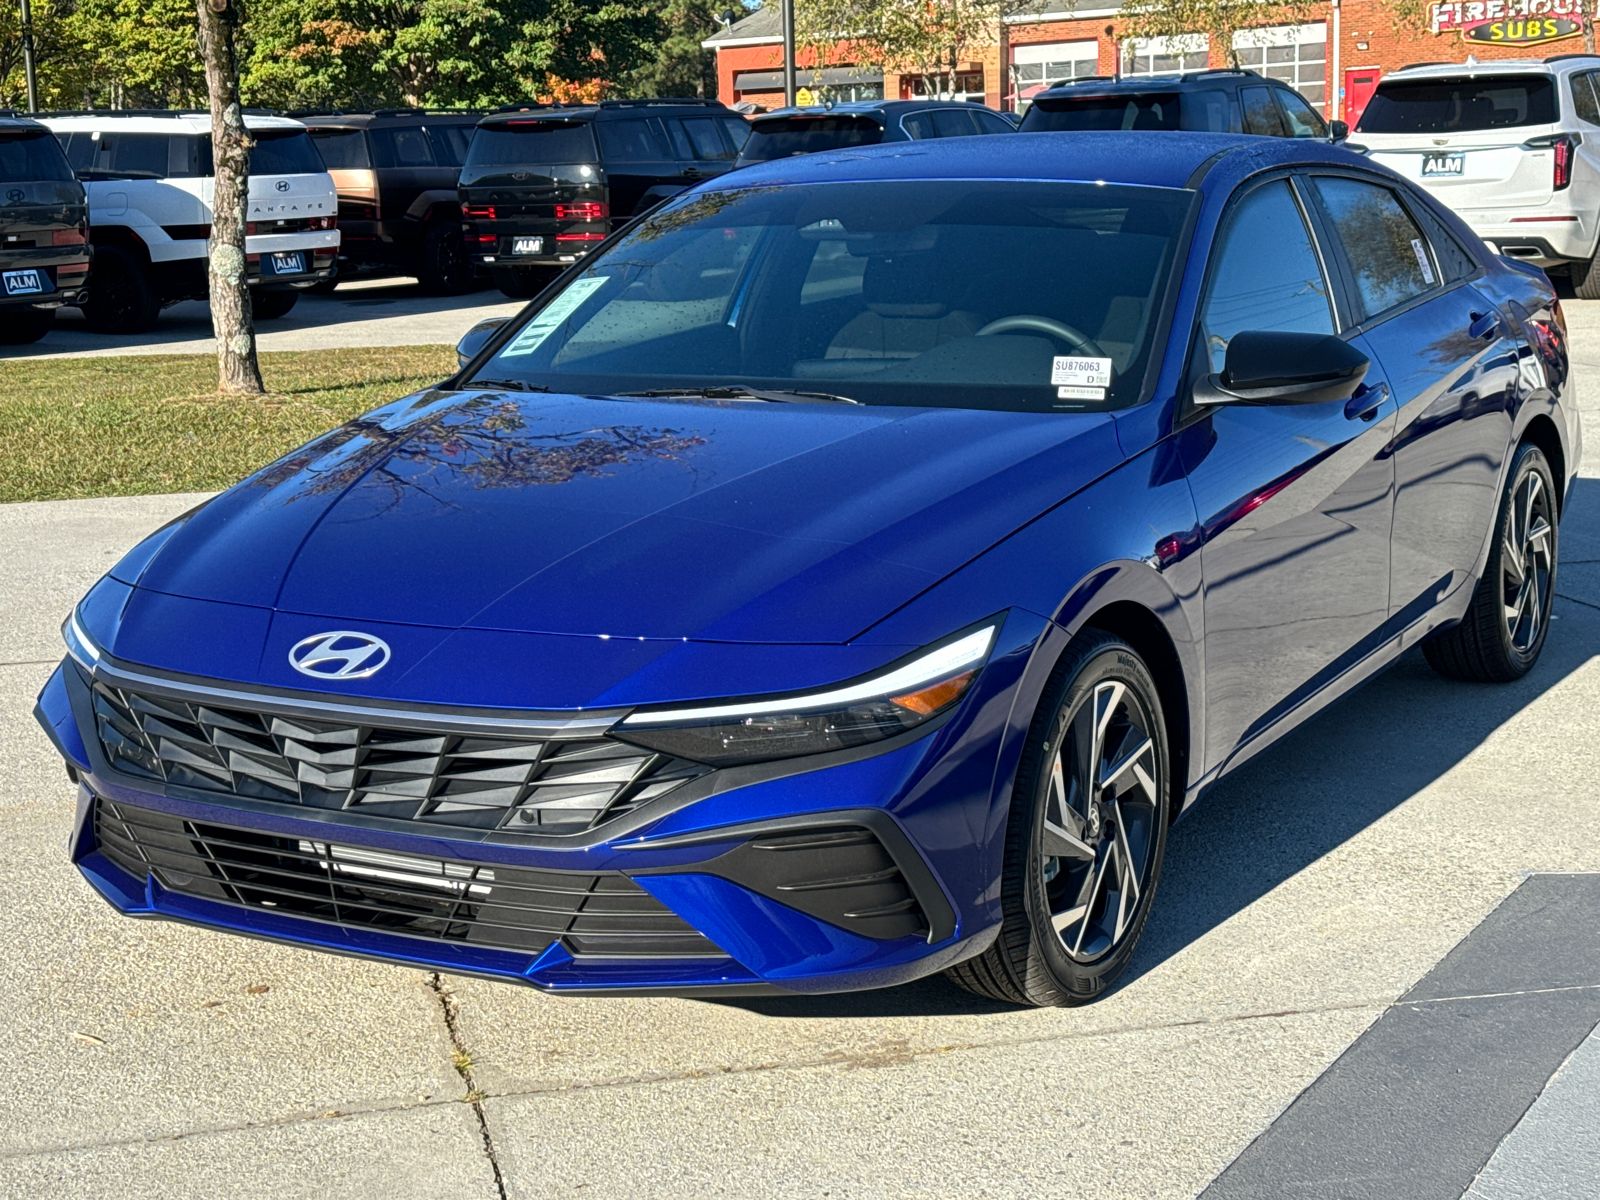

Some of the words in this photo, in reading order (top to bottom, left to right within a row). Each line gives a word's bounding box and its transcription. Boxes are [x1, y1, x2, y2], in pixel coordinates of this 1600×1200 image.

[1432, 0, 1600, 34] FIREHOU
[1489, 19, 1558, 40] SUBS
[1425, 157, 1461, 173] ALM
[254, 205, 297, 213] ANTA
[515, 240, 540, 251] ALM
[277, 257, 297, 269] ALM
[10, 275, 37, 289] ALM
[1055, 360, 1100, 371] SU876063
